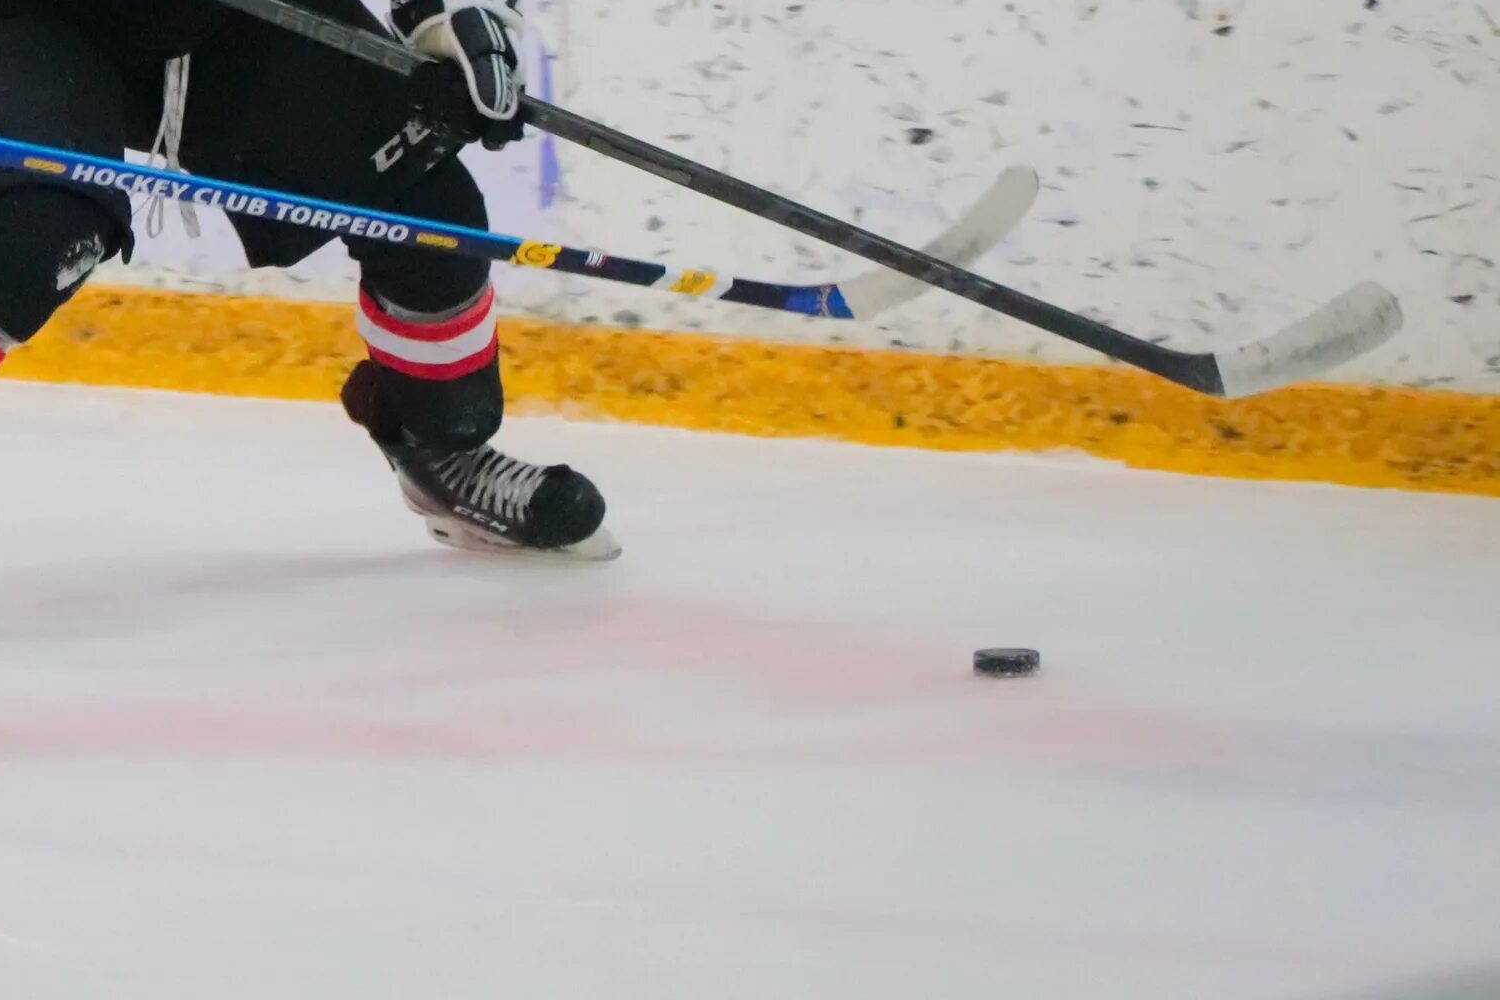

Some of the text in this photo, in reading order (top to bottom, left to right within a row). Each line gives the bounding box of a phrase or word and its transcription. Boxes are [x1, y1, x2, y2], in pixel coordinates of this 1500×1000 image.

[71, 163, 190, 201] HOCKEY
[192, 187, 268, 217] CLUB
[276, 201, 409, 242] TORPEDO
